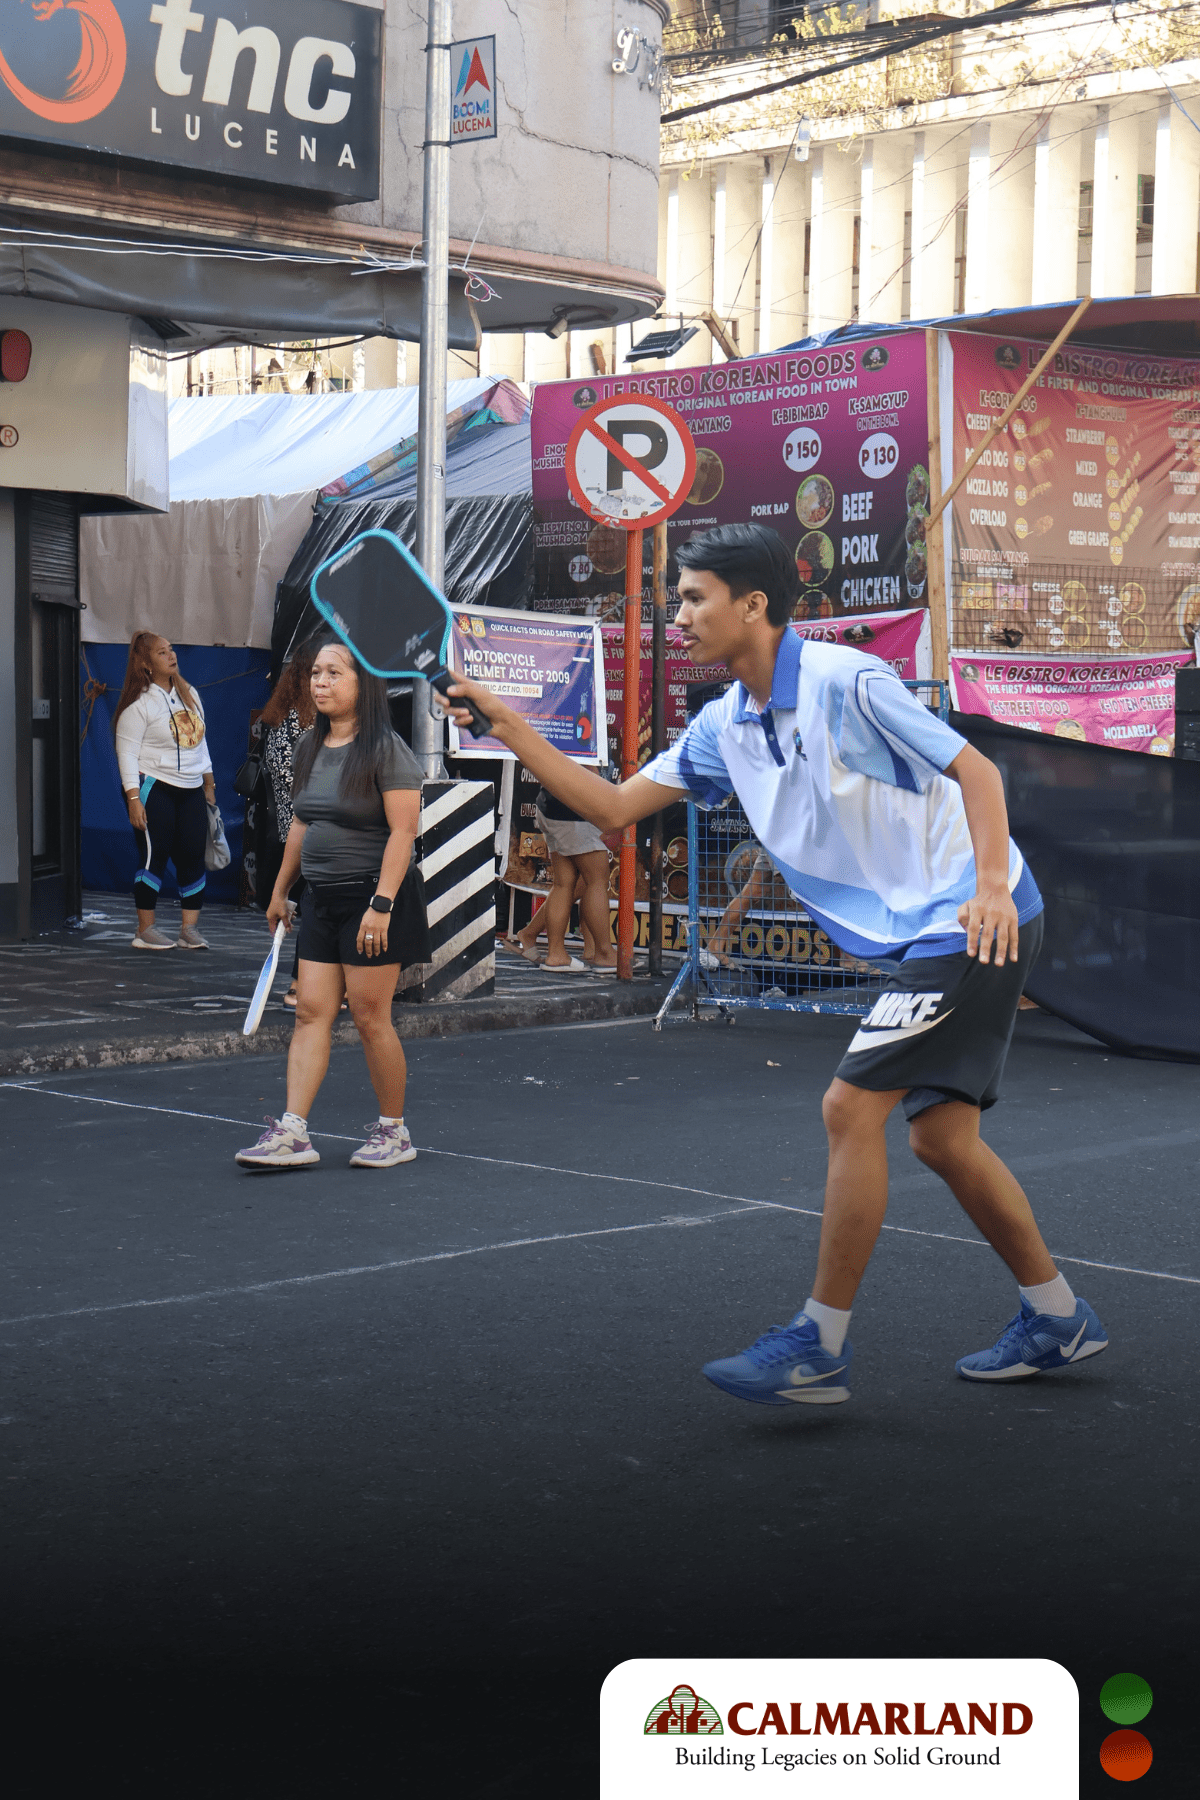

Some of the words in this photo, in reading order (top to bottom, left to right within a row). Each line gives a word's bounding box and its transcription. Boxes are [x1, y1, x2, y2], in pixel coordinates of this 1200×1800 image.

[149, 0, 356, 125] tnc
[453, 99, 490, 119] BOOM!
[453, 117, 492, 134] LUCENA
[151, 107, 356, 169] LUCENA
[629, 374, 695, 398] BISTRO
[700, 361, 781, 395] KOREAN
[786, 350, 857, 381] FOODS
[1053, 352, 1120, 379] BISTRO
[676, 395, 727, 412] ORIGINAL
[729, 388, 774, 405] KOREAN
[776, 384, 807, 399] FOOD
[810, 382, 822, 395] IN
[824, 376, 858, 392] TOWN
[1047, 376, 1074, 390] FIRST
[1077, 380, 1099, 393] AND
[1101, 382, 1151, 399] ORIGINAL
[1151, 388, 1191, 402] KOREAN
[848, 390, 909, 415] K-SAMGYUP
[772, 402, 829, 425] K-BIBIMBAP
[880, 413, 899, 428] BOWL
[966, 413, 991, 431] CHEESY
[1065, 427, 1105, 446] STRAWBERRY
[544, 443, 568, 456] ENOK
[785, 443, 793, 460] P
[797, 439, 819, 459] 150
[861, 449, 870, 467] P
[873, 445, 896, 465] 130
[992, 450, 1009, 467] DOG
[533, 458, 567, 471] MUSHR
[1075, 460, 1098, 476] MIXED
[967, 478, 992, 496] MOZZA
[992, 480, 1009, 497] DOG
[842, 491, 873, 523] BEEF
[1073, 492, 1103, 508] ORANGE
[751, 504, 772, 517] PORK
[773, 502, 790, 515] BAP
[970, 508, 1007, 527] OVERLOAD
[667, 520, 677, 528] ICK
[677, 519, 691, 527] YOUR
[692, 517, 718, 526] TOPPINGS
[536, 533, 588, 548] MUSHROOM
[1068, 530, 1087, 545] GREEN
[1088, 531, 1110, 547] GRAPES
[841, 534, 879, 565] PORK
[840, 576, 900, 608] CHICKEN
[1032, 582, 1061, 593] CHEESE
[490, 623, 509, 632] QUICK
[510, 625, 529, 635] FACTS
[529, 627, 538, 636] ON
[538, 628, 555, 637] ROAD
[555, 630, 576, 639] SAFETY
[576, 631, 593, 640] LAWS
[463, 648, 536, 667] MOTORCYCLE
[611, 648, 625, 660] FIR
[464, 664, 507, 679] HELMET
[508, 667, 529, 681] ACT
[530, 669, 544, 682] OF
[546, 670, 570, 685] 2009
[671, 666, 707, 681] K-STREET
[984, 665, 1005, 681] LE
[1006, 665, 1066, 684] BISTRO
[1068, 665, 1132, 683] KOREAN
[1133, 661, 1181, 680] FOODS
[480, 682, 498, 692] UBLIC
[498, 684, 512, 693] ACT
[522, 685, 540, 695] 10054
[668, 684, 687, 696] FISHCA
[984, 684, 1000, 694] THE
[1001, 684, 1023, 694] FIRST
[1025, 684, 1043, 694] AND
[1045, 683, 1088, 694] ORIGINAL
[1089, 683, 1120, 694] KOREAN
[1121, 680, 1145, 691] FOOD
[1146, 679, 1156, 689] IN
[1157, 678, 1176, 689] TOW
[989, 700, 1036, 716] K-STREET
[1036, 700, 1070, 715] FOOD
[1120, 696, 1138, 712] YEN
[1139, 694, 1173, 711] CHEESE
[1103, 724, 1158, 740] MOZZARELLA
[521, 803, 537, 817] BULD
[860, 991, 944, 1028] NIKE
